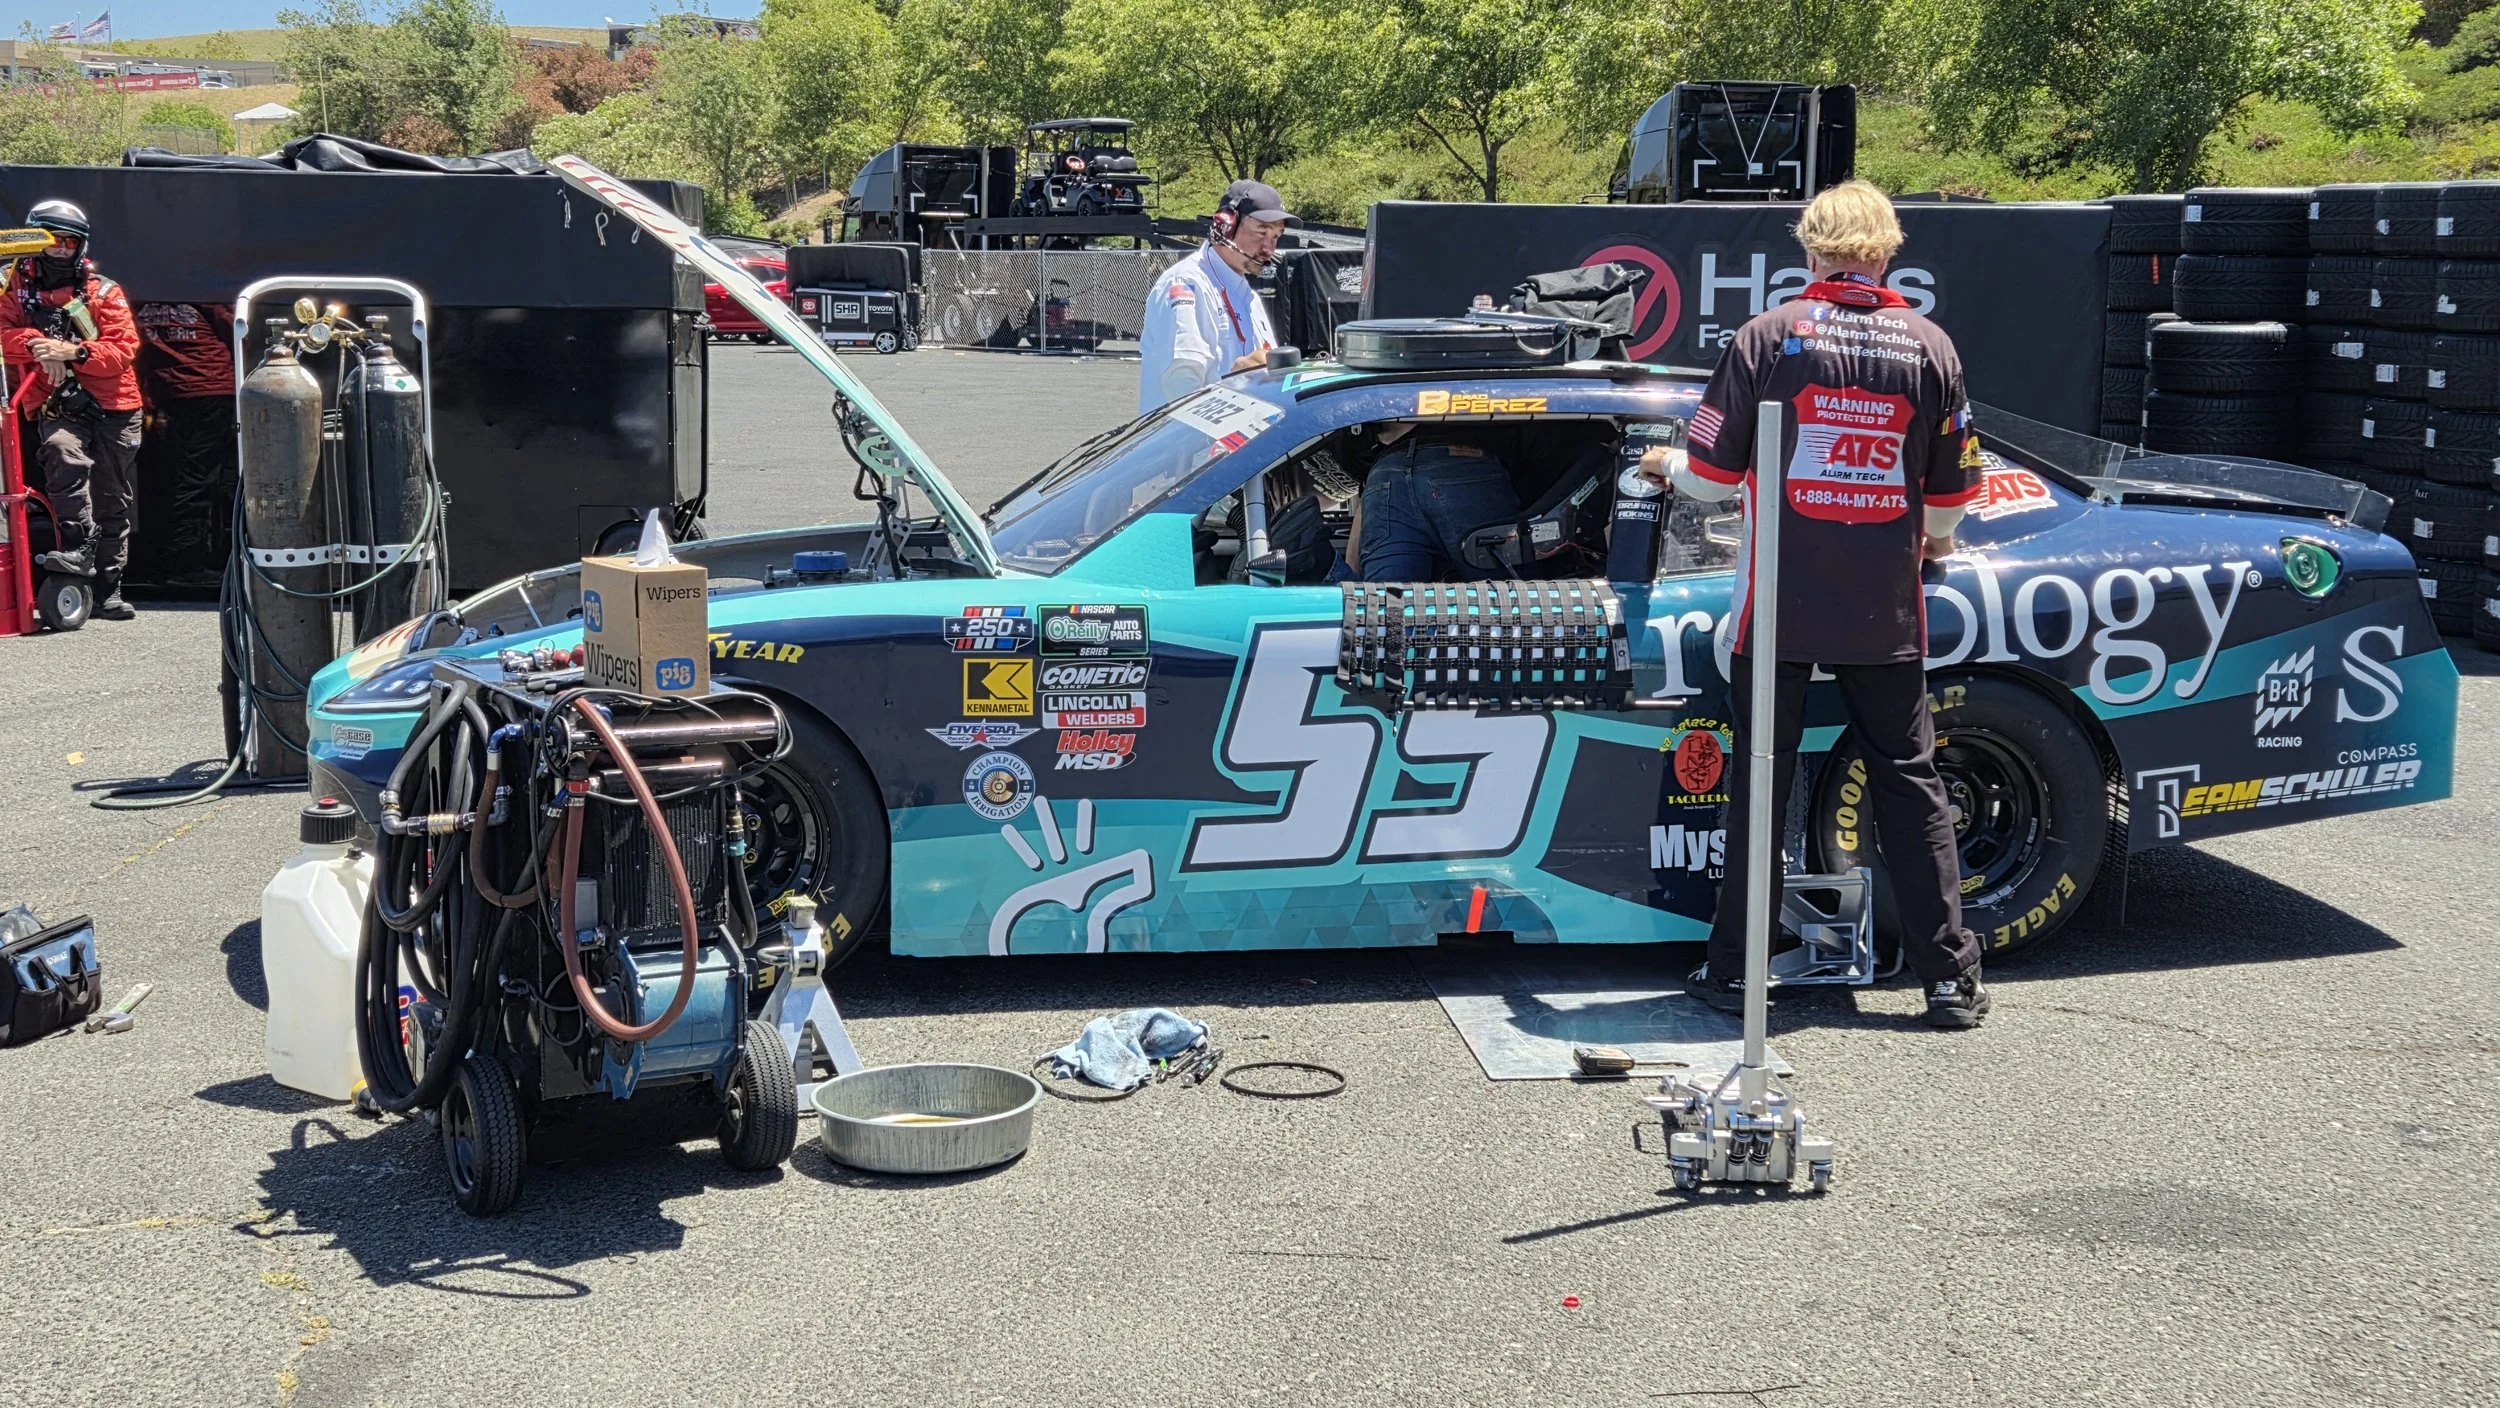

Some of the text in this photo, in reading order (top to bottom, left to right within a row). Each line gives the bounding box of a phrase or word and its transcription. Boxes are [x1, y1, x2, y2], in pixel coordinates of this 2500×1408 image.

[1699, 253, 1936, 317] Has
[835, 304, 859, 315] SHR
[1829, 307, 1908, 330] Alarm Tech
[1815, 323, 1921, 349] @AlarmTechInc
[1802, 338, 1928, 368] @AlarmTechInc501
[1186, 396, 1245, 425] PEREZ
[1450, 398, 1547, 414] PEREZ
[1813, 394, 1895, 416] WARNING
[1816, 410, 1889, 425] PROTECTED BY
[1620, 445, 1644, 456] Casa
[1826, 433, 1900, 471] ATS
[1819, 469, 1886, 482] ALARM TECH
[1794, 488, 1908, 508] 1-888-44-MY-ATS
[1987, 472, 2047, 506] ATS
[1616, 502, 1659, 511] BRYANT
[1617, 510, 1655, 519] ADKINS
[646, 586, 701, 602] Wipers
[584, 594, 602, 628] pig
[1080, 605, 1116, 614] NASCAR
[965, 618, 1014, 637] 250
[1046, 616, 1111, 644] O'Reilly
[1112, 620, 1139, 630] AUTO
[1110, 630, 1142, 641] PARTS
[714, 640, 805, 664] YEAR
[1079, 647, 1109, 656] SERIES
[585, 640, 638, 688] Wipers
[1041, 662, 1146, 686] COMETIC
[659, 661, 691, 688] pig
[966, 703, 1030, 714] KENNAMETAL
[1047, 695, 1128, 711] LINCOLN
[1065, 713, 1136, 726] WELDERS
[949, 725, 1017, 735] FIVE STAR
[1056, 729, 1136, 756] Holley
[1188, 628, 1552, 866] 55
[2257, 736, 2303, 748] RACING
[1054, 752, 1123, 771] MSD
[2338, 743, 2418, 765] COMPASS
[971, 755, 1027, 776] CHAMPION
[970, 795, 1029, 818] IRRIGATION
[1666, 793, 1730, 805] TAQUERIA
[1649, 824, 1727, 872] Mys
[1993, 872, 2078, 948] EAGLE
